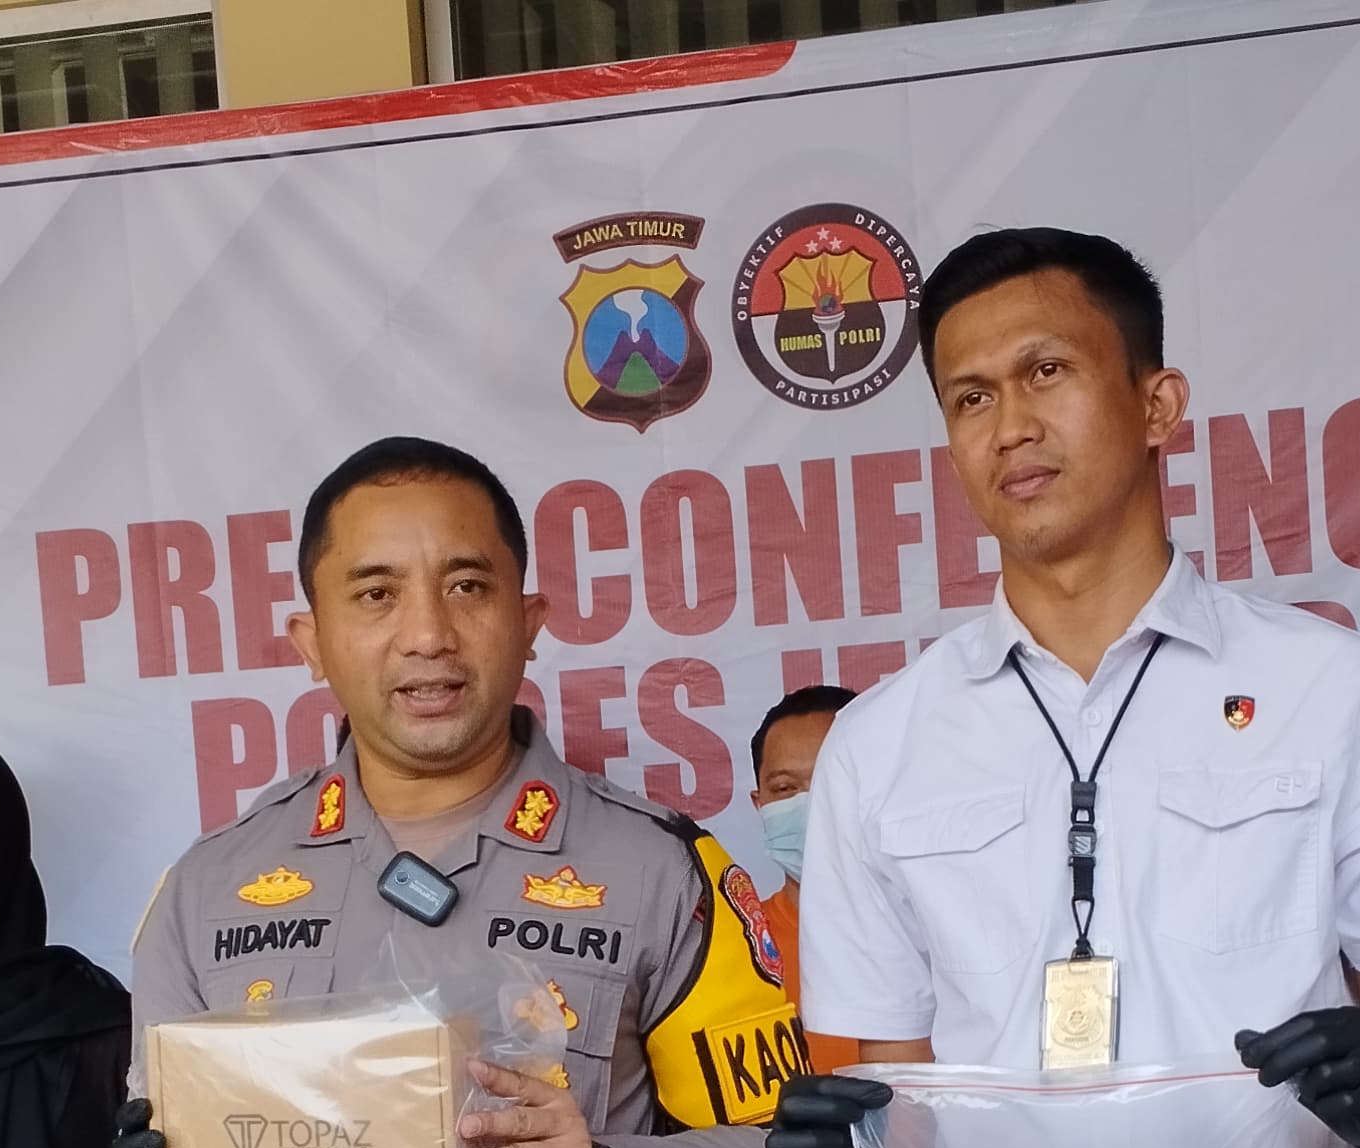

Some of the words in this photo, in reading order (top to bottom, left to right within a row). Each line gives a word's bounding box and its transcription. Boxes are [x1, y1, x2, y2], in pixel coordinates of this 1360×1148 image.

[572, 224, 624, 251] JAWA
[626, 219, 686, 239] TIMUR
[737, 225, 785, 321] OBYEKTIF
[853, 212, 921, 311] DIPERCAYA
[779, 333, 823, 353] HUMAS
[838, 327, 882, 346] POLRI
[774, 366, 893, 406] PARTISIPASI
[36, 510, 306, 686] PRE
[214, 917, 332, 961] HIDAYAT
[487, 918, 623, 965] POLRI
[270, 1119, 374, 1147] TOPAZ
